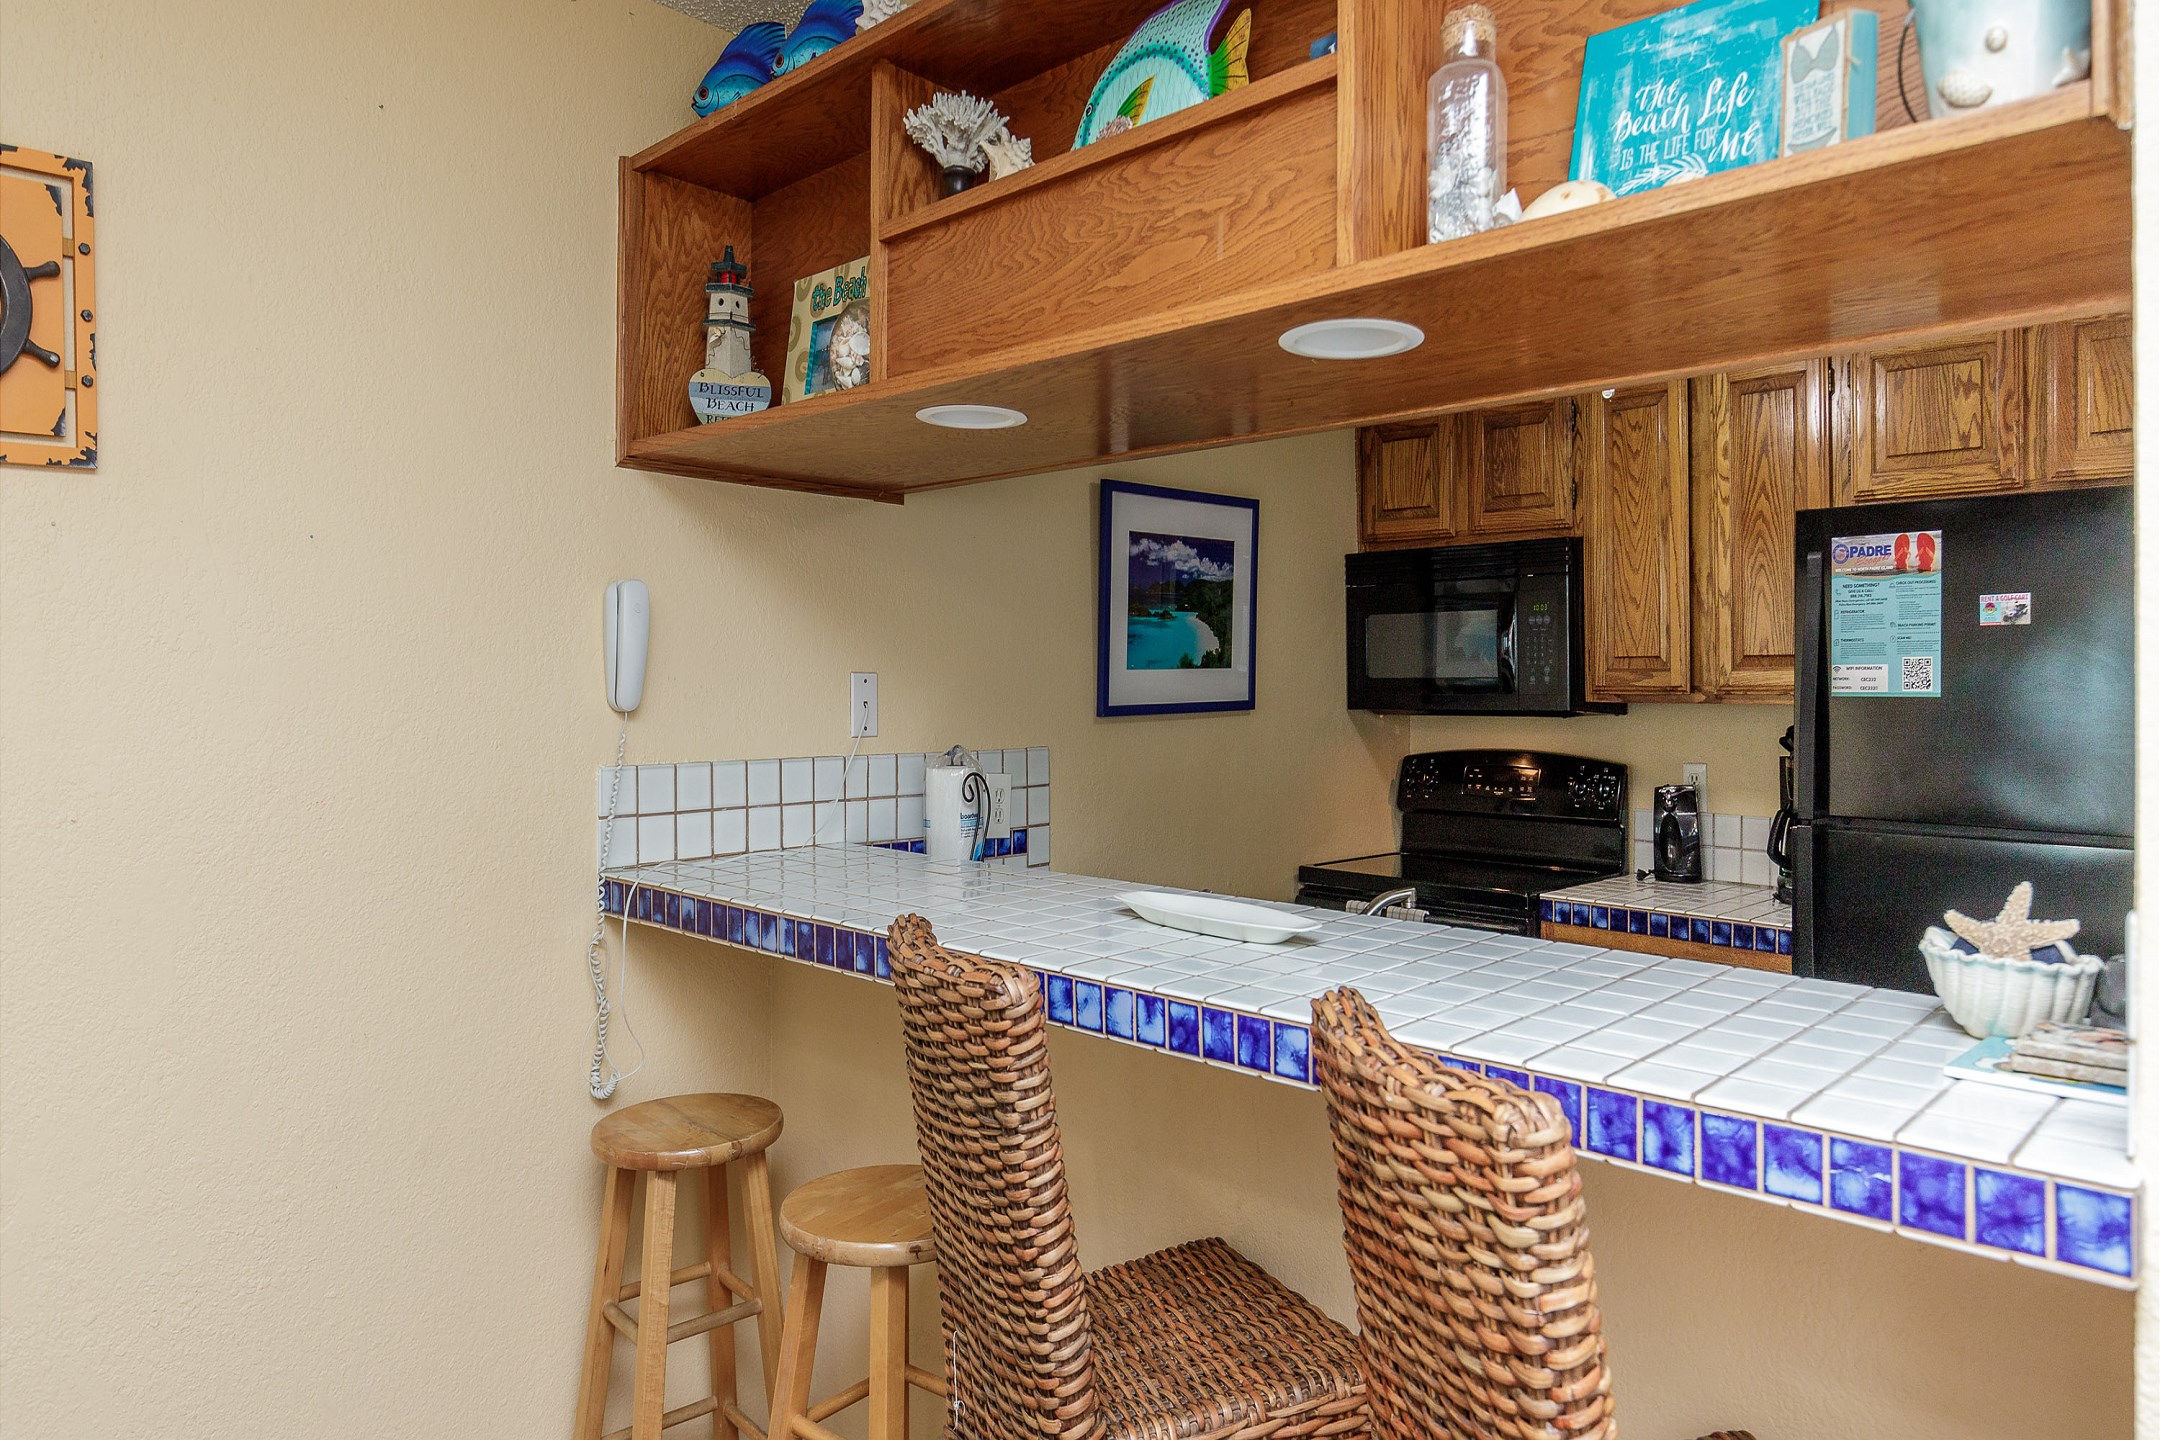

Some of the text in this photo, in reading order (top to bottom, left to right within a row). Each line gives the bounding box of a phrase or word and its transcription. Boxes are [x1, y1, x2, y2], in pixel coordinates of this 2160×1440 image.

[1611, 93, 1691, 143] Beach
[1697, 71, 1755, 129] Life
[1619, 149, 1634, 171] IS
[1639, 141, 1661, 165] THE
[1664, 133, 1691, 160] LIFE
[1694, 127, 1719, 151] FOR
[812, 266, 867, 311] the Beach
[698, 382, 764, 398] BLISSFUL
[706, 397, 755, 412] BEACH
[1850, 544, 1892, 558] PADRE
